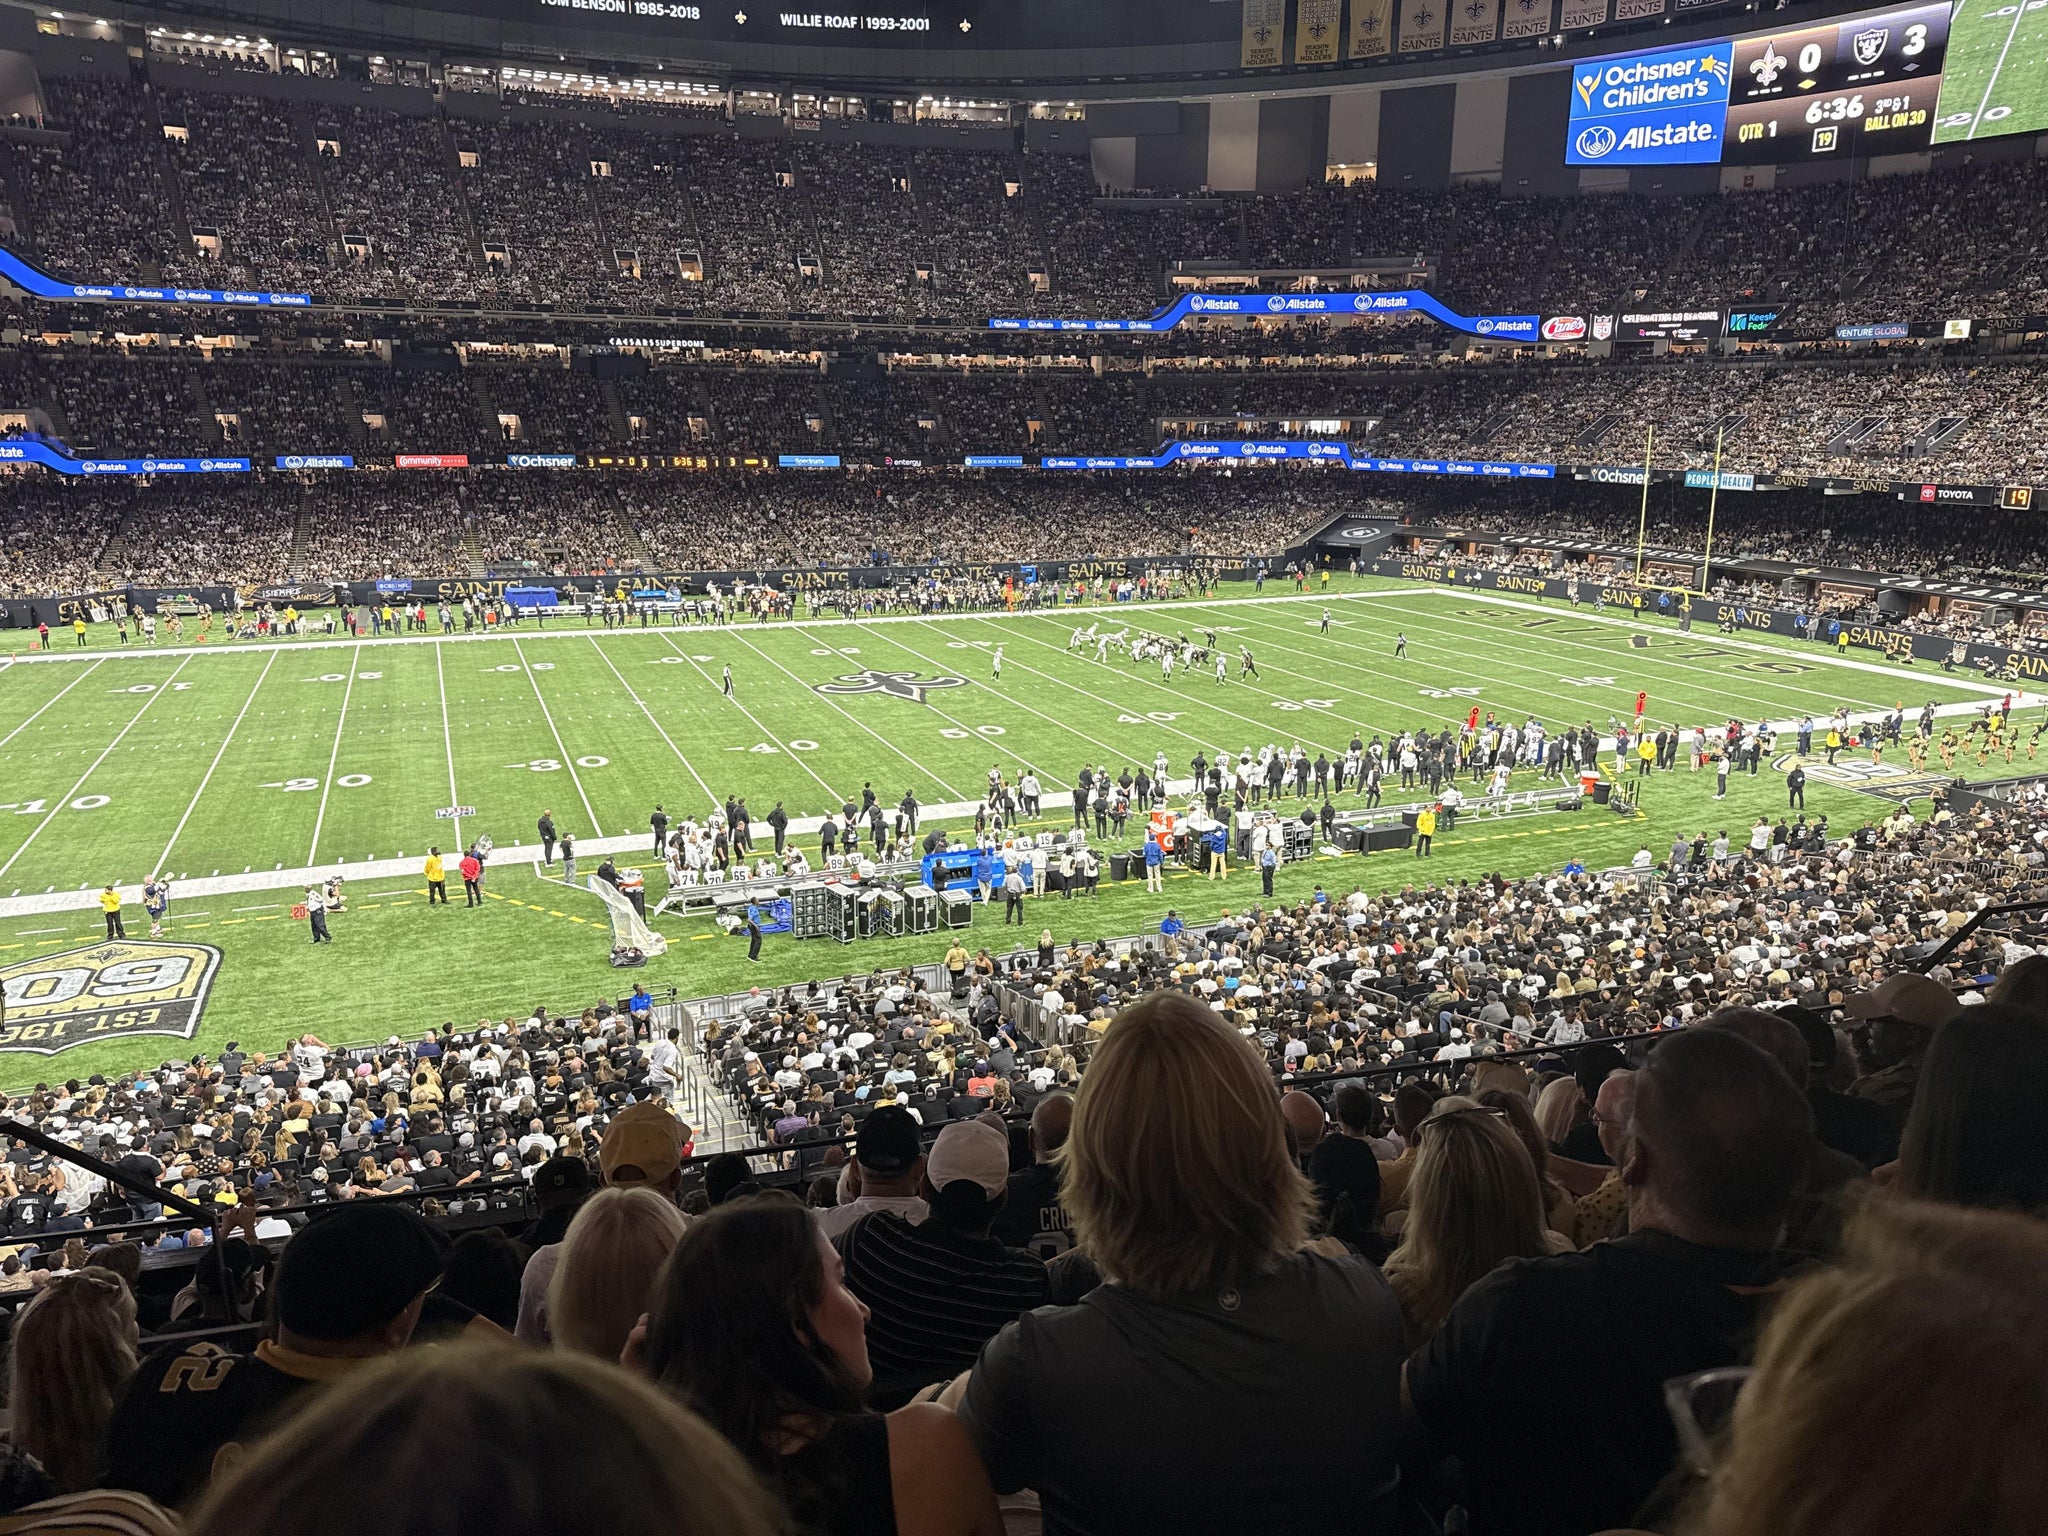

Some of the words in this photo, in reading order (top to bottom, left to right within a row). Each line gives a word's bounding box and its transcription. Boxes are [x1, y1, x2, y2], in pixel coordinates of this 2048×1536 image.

[572, 0, 625, 13] BENSON
[634, 2, 701, 19] 1985-2018
[1618, 3, 1661, 17] SAINTS
[780, 13, 822, 27] WILLIE
[824, 14, 858, 29] ROAF
[865, 17, 930, 31] 1993-2001
[1564, 12, 1604, 27] SAINTS
[1506, 23, 1546, 36] SAINTS
[1453, 30, 1493, 44] SAINTS
[1902, 24, 1928, 56] 3
[1353, 46, 1385, 55] HOLDERS
[1401, 38, 1441, 51] SAINTS
[1798, 43, 1822, 73] 0
[1604, 58, 1697, 86] Ochsner
[1603, 78, 1709, 109] Children's
[1805, 95, 1864, 125] 6:36
[1865, 116, 1891, 132] BALL
[1892, 112, 1908, 128] ON
[1909, 109, 1926, 126] 30
[1616, 120, 1713, 151] Allstate
[1738, 123, 1764, 144] QTR
[1767, 121, 1777, 138] 1
[1816, 132, 1832, 146] 19
[86, 288, 113, 297] Allstate
[136, 290, 163, 298] Allstate
[186, 292, 212, 300] Allstate
[235, 294, 260, 302] Allstate
[282, 295, 306, 304] Allstate
[325, 296, 361, 306] SAINTS
[1203, 298, 1239, 311] Allstate
[1285, 298, 1325, 309] Allstate
[1372, 296, 1408, 308] Allstate
[1749, 313, 1776, 322] Keesle
[1493, 321, 1533, 332] Allstate
[1986, 318, 2025, 330] SAINTS
[1793, 328, 1827, 338] SAINTS
[1836, 328, 1873, 338] VENTURE
[1874, 326, 1908, 336] GLOBAL
[655, 339, 705, 348] SUPERDOME
[1190, 445, 1220, 455] Allstate
[1256, 445, 1287, 455] Allstate
[97, 462, 128, 471] Allstate
[156, 462, 186, 471] Allstate
[214, 461, 242, 470] Allstate
[304, 457, 344, 467] Allstate
[358, 457, 391, 466] SAINTS
[400, 455, 442, 466] Community
[519, 455, 575, 467] Ochsner
[674, 457, 692, 466] 6:36
[843, 457, 870, 465] SAINTS
[894, 458, 921, 467] entergy
[1057, 459, 1077, 467] Allstate
[1096, 459, 1116, 467] Allstate
[1134, 459, 1154, 467] Allstate
[1721, 474, 1753, 488] HEALTH
[1774, 476, 1808, 487] SAINTS
[1852, 481, 1889, 493] SAINTS
[1938, 489, 1973, 500] TOYOTA
[2010, 489, 2028, 506] 19
[1068, 562, 1127, 578] SAINTS
[1401, 565, 1441, 581] SAINTS
[1496, 575, 1540, 592] SAINTS
[58, 594, 128, 623] SANTS
[1718, 606, 1771, 629] SANTS
[1850, 624, 1913, 653] SAINTS
[2006, 653, 2048, 684] SAIN
[939, 725, 1006, 739] 50
[749, 740, 819, 754] 40
[529, 756, 609, 771] 30
[283, 774, 372, 792] 20
[711, 820, 719, 829] 19
[1041, 835, 1050, 845] 15
[831, 859, 842, 869] 89
[682, 874, 694, 884] 74
[734, 870, 745, 881] 65
[293, 906, 306, 918] 20
[0, 1018, 73, 1045] 196
[22, 1205, 35, 1224] 4
